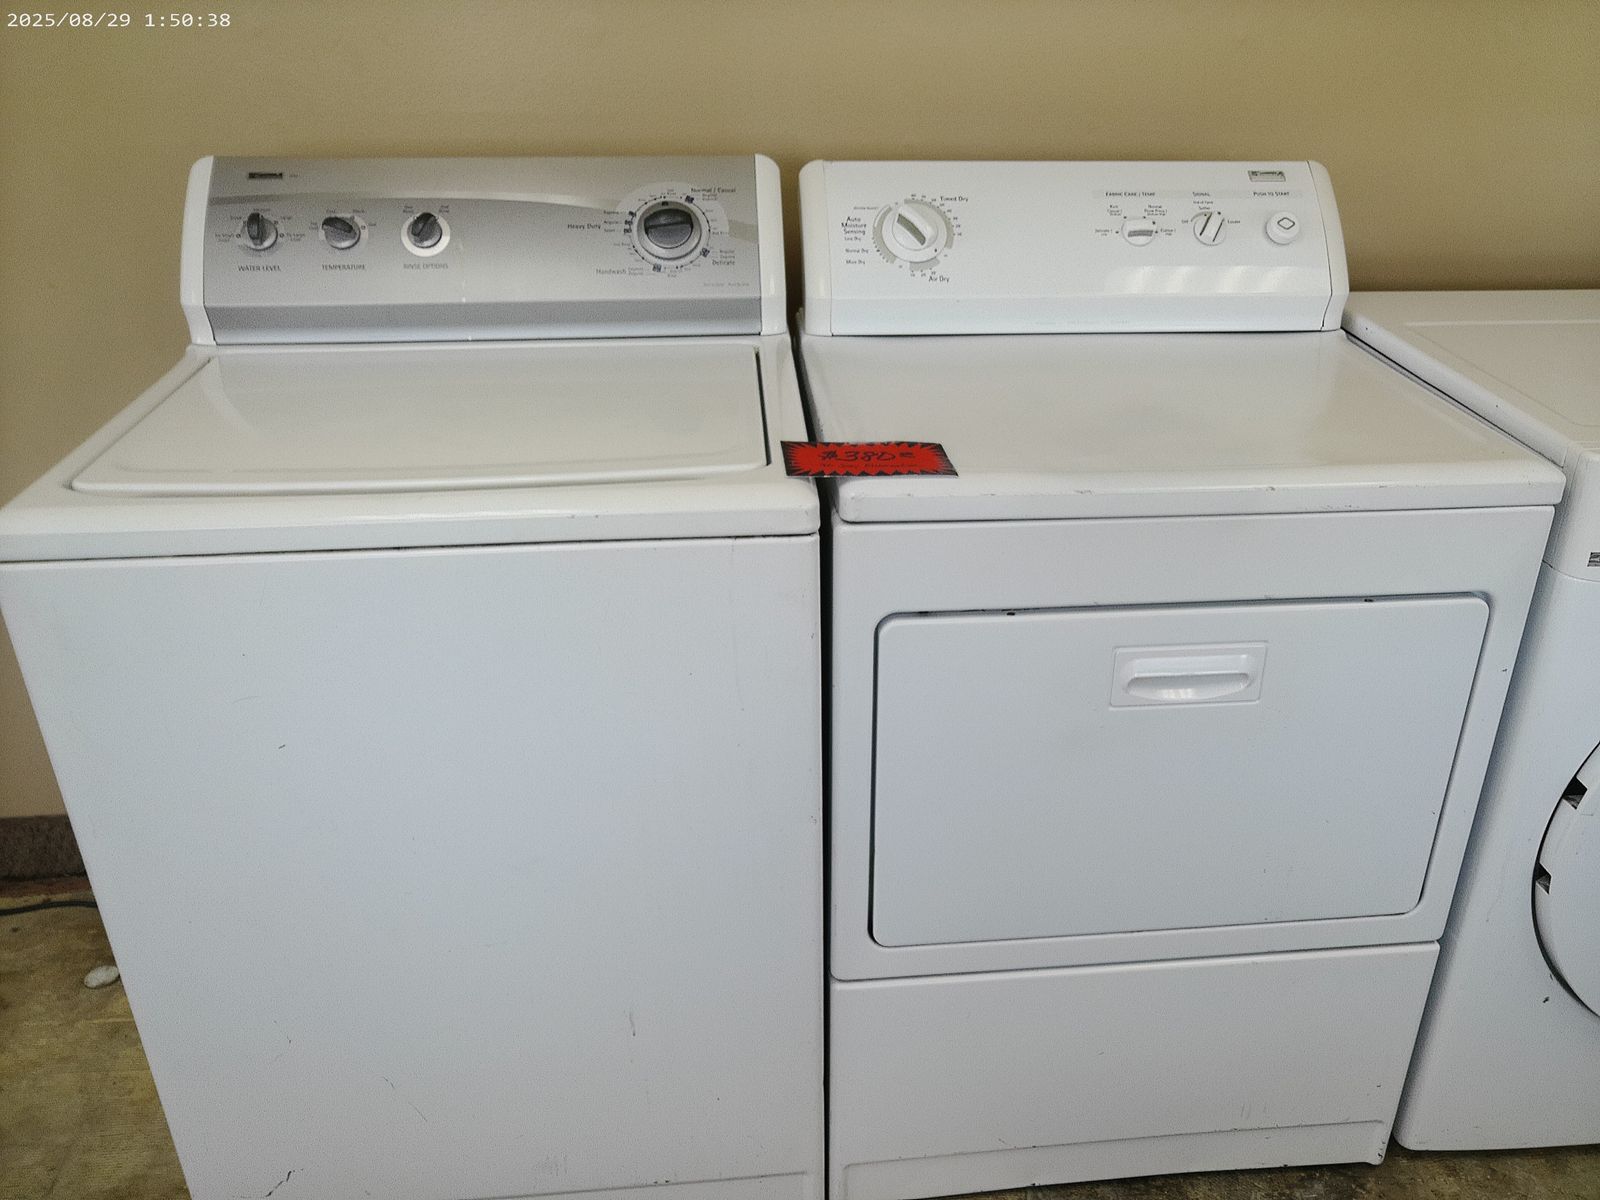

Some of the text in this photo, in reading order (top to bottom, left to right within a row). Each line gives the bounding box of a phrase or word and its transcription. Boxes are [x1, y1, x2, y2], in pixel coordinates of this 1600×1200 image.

[238, 264, 282, 272] WATER LEVEL
[321, 263, 366, 271] TEMPERATURE
[939, 275, 950, 283] Dry
